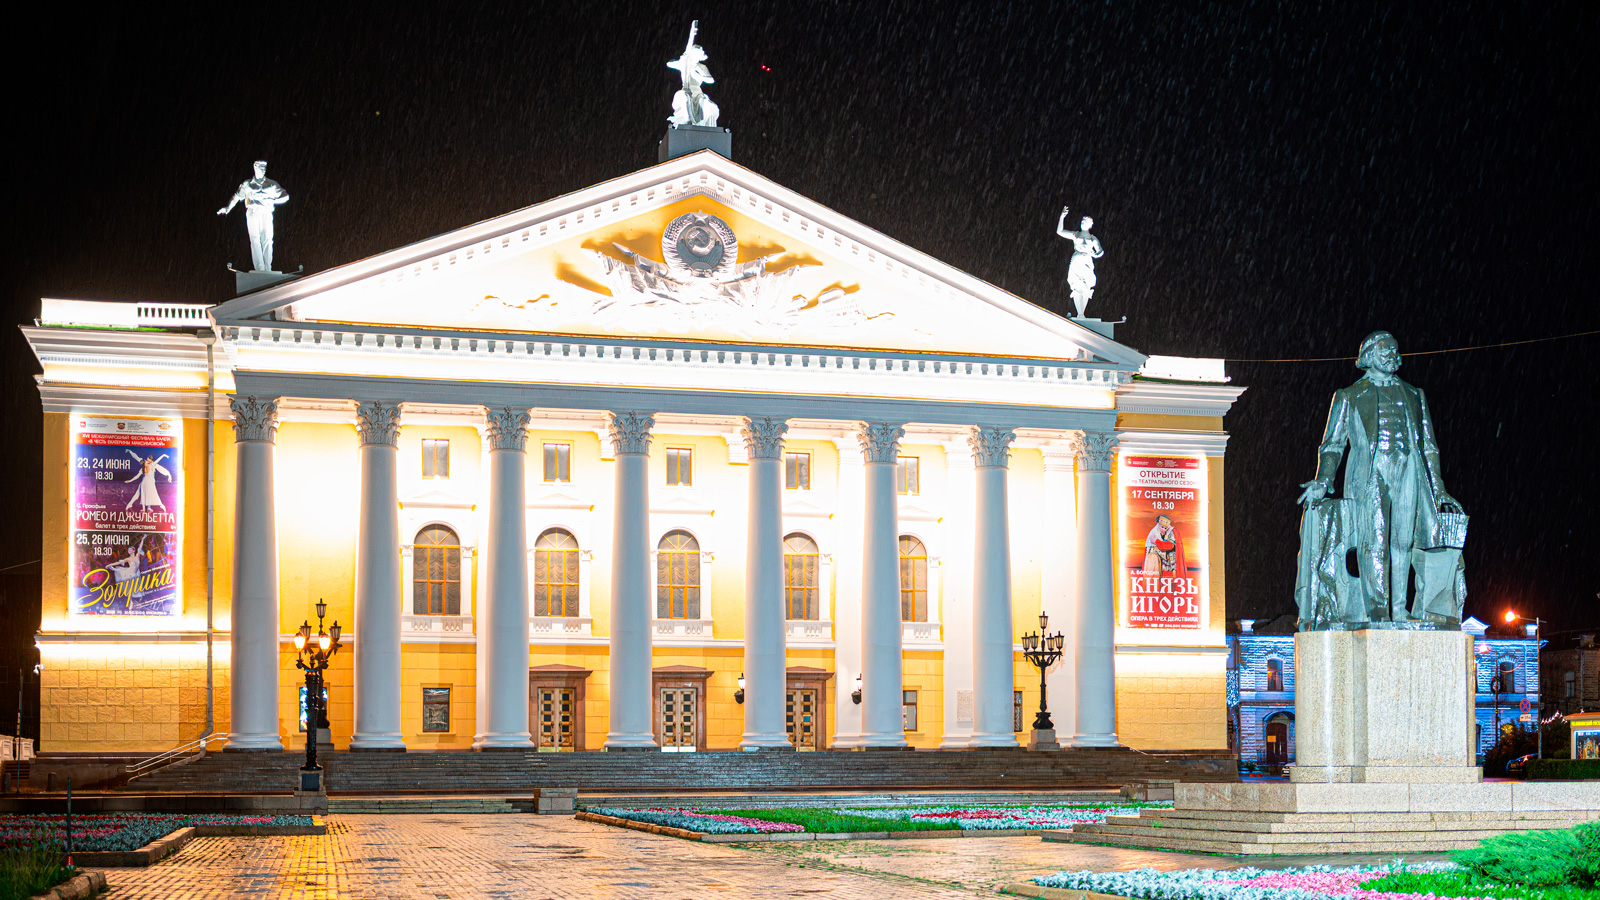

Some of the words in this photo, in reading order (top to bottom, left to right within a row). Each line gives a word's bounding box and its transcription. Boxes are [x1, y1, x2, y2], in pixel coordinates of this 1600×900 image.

[77, 457, 90, 469] 23,
[92, 458, 103, 469] 24
[105, 459, 130, 469] ИЮНЯ
[95, 472, 113, 480] 18.30
[1140, 470, 1185, 479] ОТКРЫТИЕ
[1132, 490, 1142, 498] 17
[1144, 491, 1194, 500] СЕНТЯБРЯ
[1152, 501, 1174, 509] 18.30
[76, 511, 108, 521] РОМЕО
[110, 511, 116, 521] И
[118, 512, 174, 523] ДЖУЛЬЕТТА
[76, 534, 90, 545] 25,
[92, 534, 102, 544] 26
[105, 535, 129, 545] ИЮНЯ
[94, 547, 112, 556] 18.30
[76, 568, 174, 608] Золушка
[1130, 577, 1198, 596] КНЯЗЬ
[1130, 596, 1198, 614] ИГОРЬ
